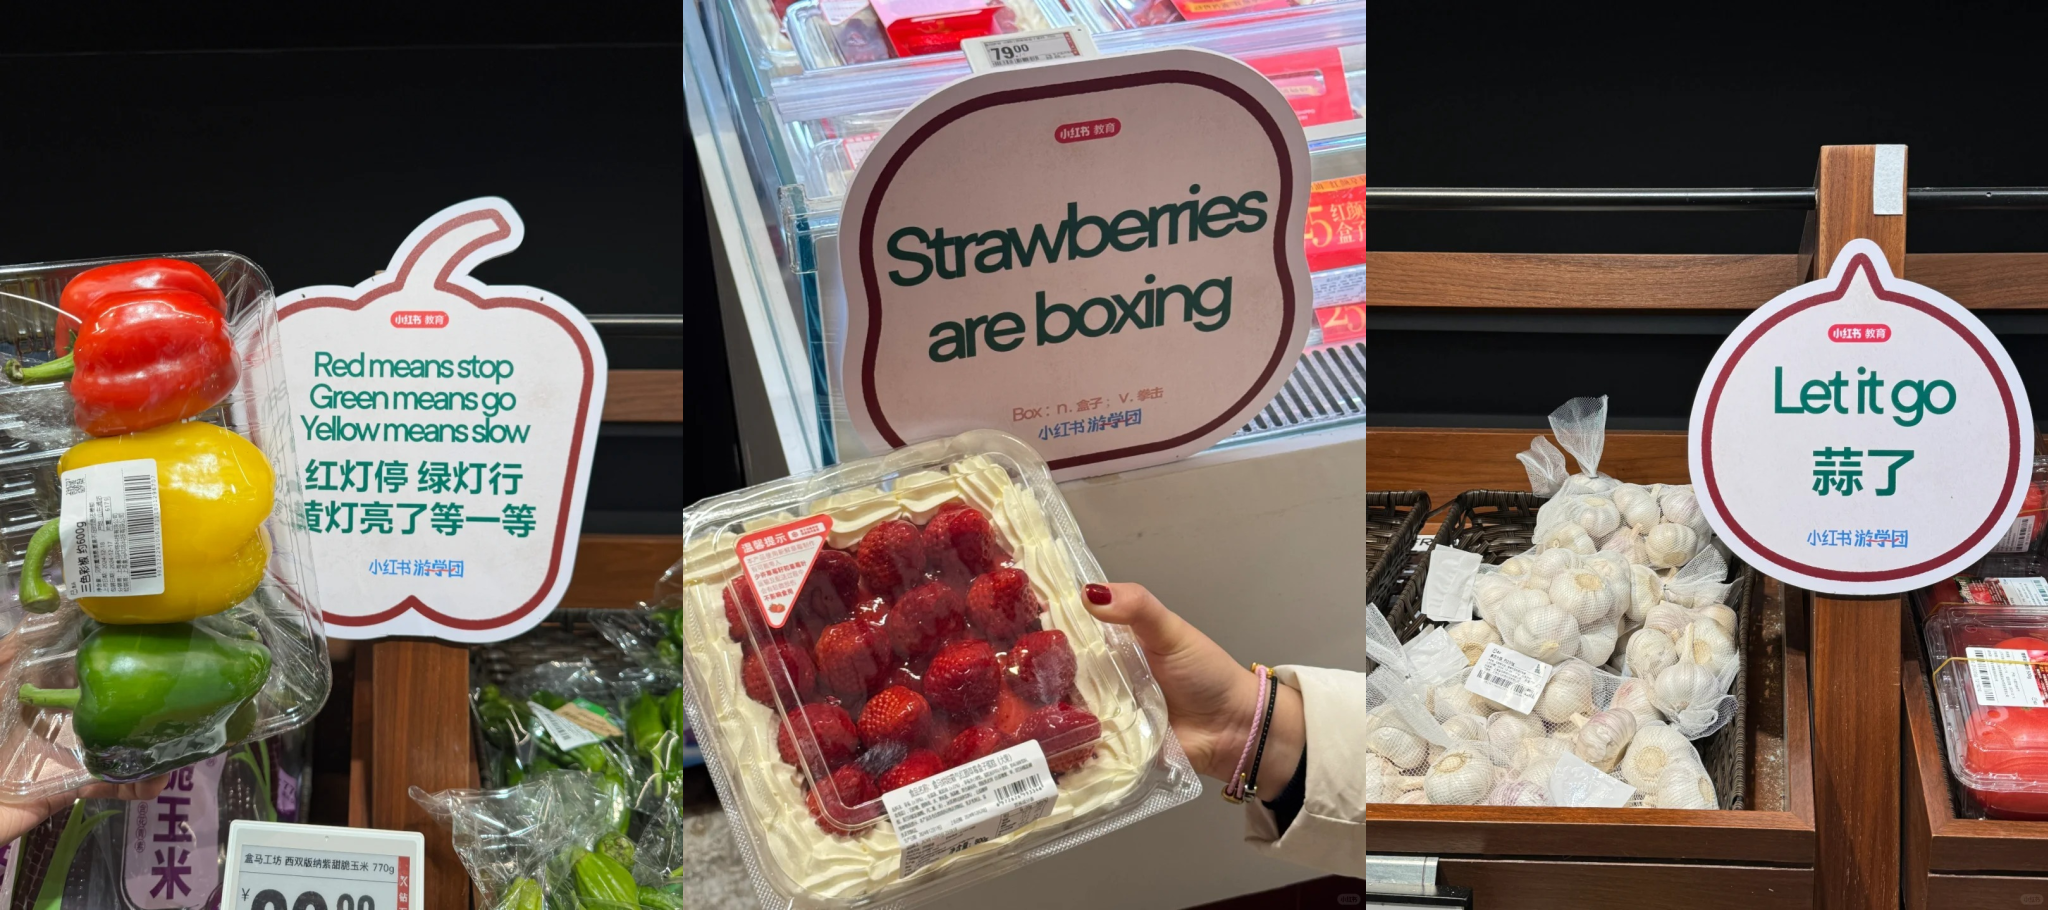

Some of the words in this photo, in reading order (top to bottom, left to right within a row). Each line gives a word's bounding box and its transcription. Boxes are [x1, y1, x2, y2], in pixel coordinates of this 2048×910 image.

[1060, 126, 1090, 140] 小红书
[1094, 122, 1116, 136] 教育
[1330, 202, 1366, 222] 红颜
[886, 183, 1269, 287] Strawberries
[395, 314, 422, 325] 小红书
[424, 314, 444, 325] 教育
[928, 311, 1026, 364] are
[1036, 274, 1233, 347] boxing
[1832, 328, 1862, 339] 小红书
[1865, 328, 1886, 339] 教育
[314, 352, 365, 378] Red
[370, 359, 454, 378] means
[457, 355, 514, 384] stop
[310, 383, 389, 410] Green
[393, 390, 478, 410] means
[482, 392, 516, 417] go
[1057, 404, 1072, 414] n.
[1136, 386, 1164, 401] 拳击
[1775, 366, 1849, 414] Let
[1857, 366, 1884, 414] it
[1891, 379, 1956, 427] go
[300, 415, 381, 442] Yellow
[384, 423, 469, 442] means
[472, 417, 531, 444] slow
[1038, 419, 1085, 441] 小红书
[1087, 408, 1142, 433] 游学团
[304, 459, 408, 493] 红灯停
[417, 460, 524, 495] 绿灯行
[1812, 446, 1914, 496] 蒜了
[75, 521, 88, 554] 约600g
[742, 532, 787, 554] 温馨提示
[1806, 530, 1852, 547] 小红书
[1854, 530, 1908, 548] 游学团
[78, 556, 92, 592] 三色彩椒
[369, 559, 411, 575] 小红书
[413, 559, 464, 578] 游学团
[244, 853, 282, 865] 盒马工坊
[285, 856, 369, 871] 西双版纳紫甜脆玉米
[373, 863, 394, 875] 770g
[241, 888, 250, 901] ¥
